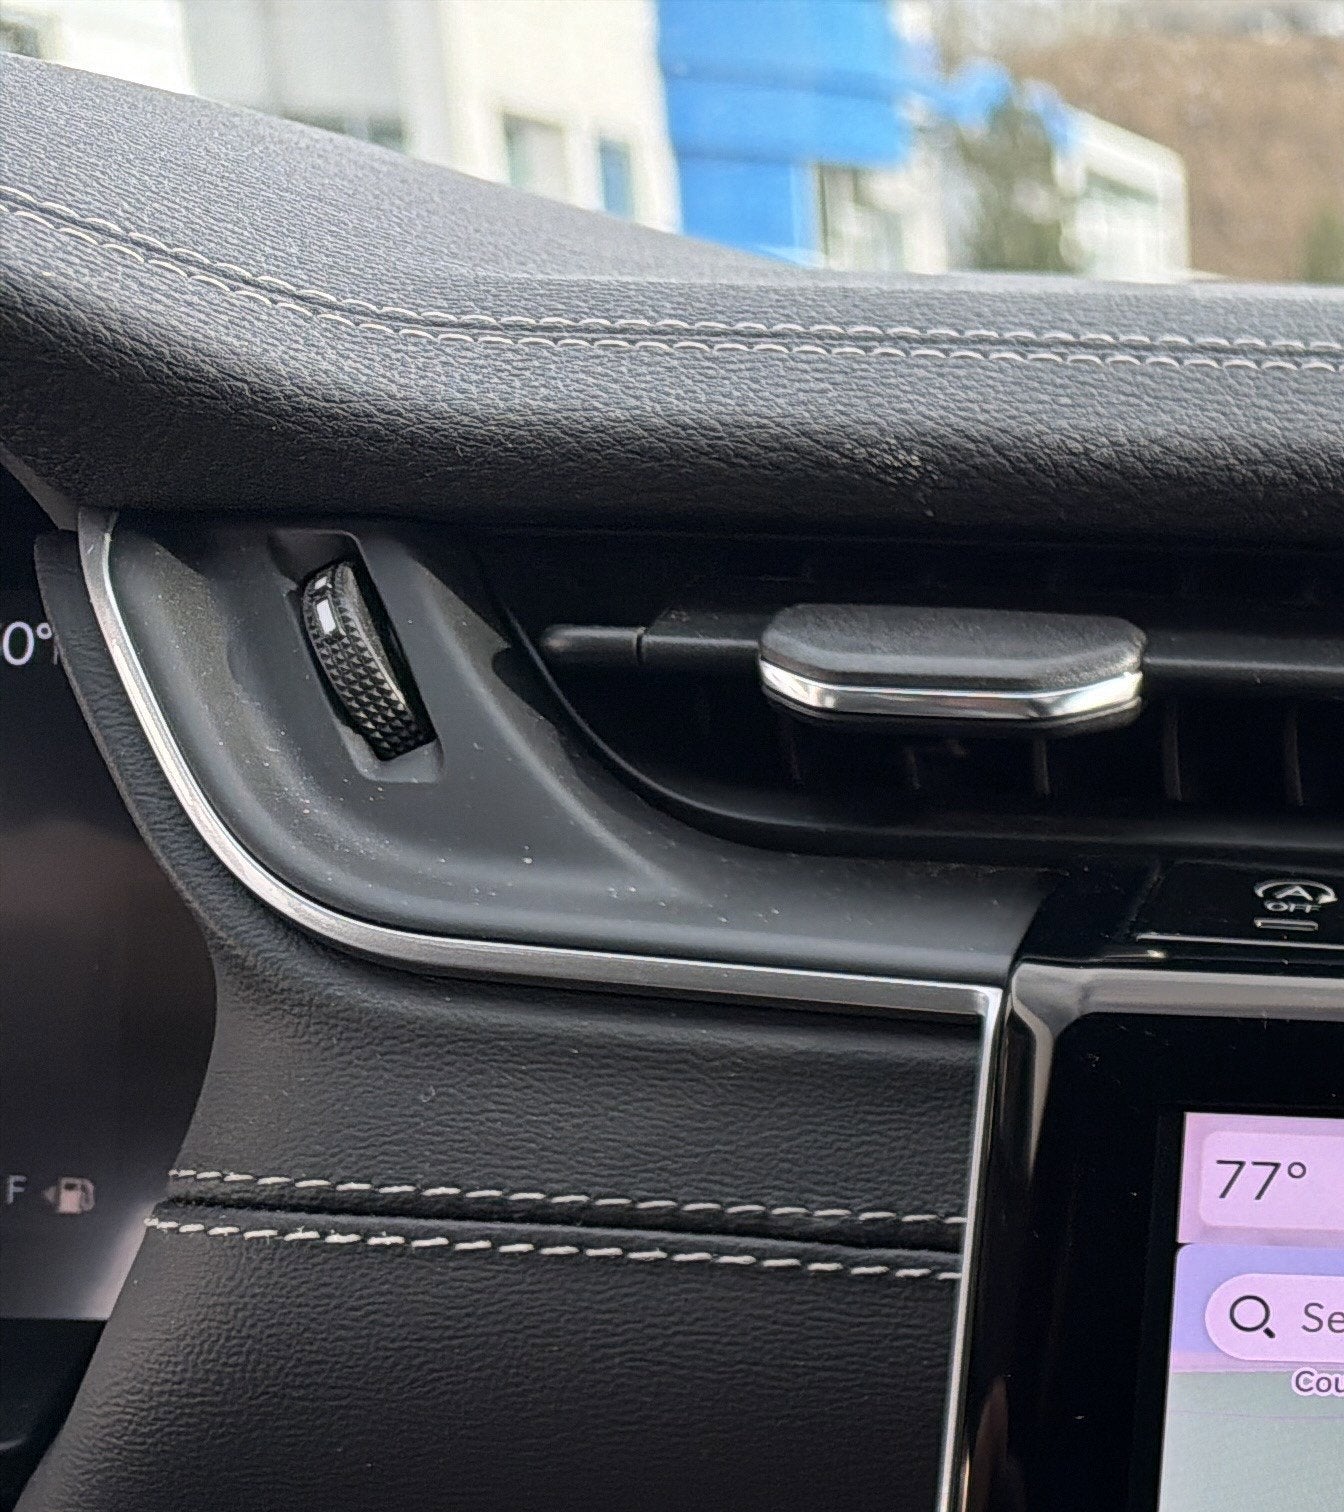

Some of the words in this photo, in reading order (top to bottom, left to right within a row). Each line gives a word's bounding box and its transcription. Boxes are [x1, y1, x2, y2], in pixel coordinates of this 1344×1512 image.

[1265, 900, 1320, 912] OFF
[6, 1174, 27, 1204] F
[1215, 1159, 1307, 1201] 77°
